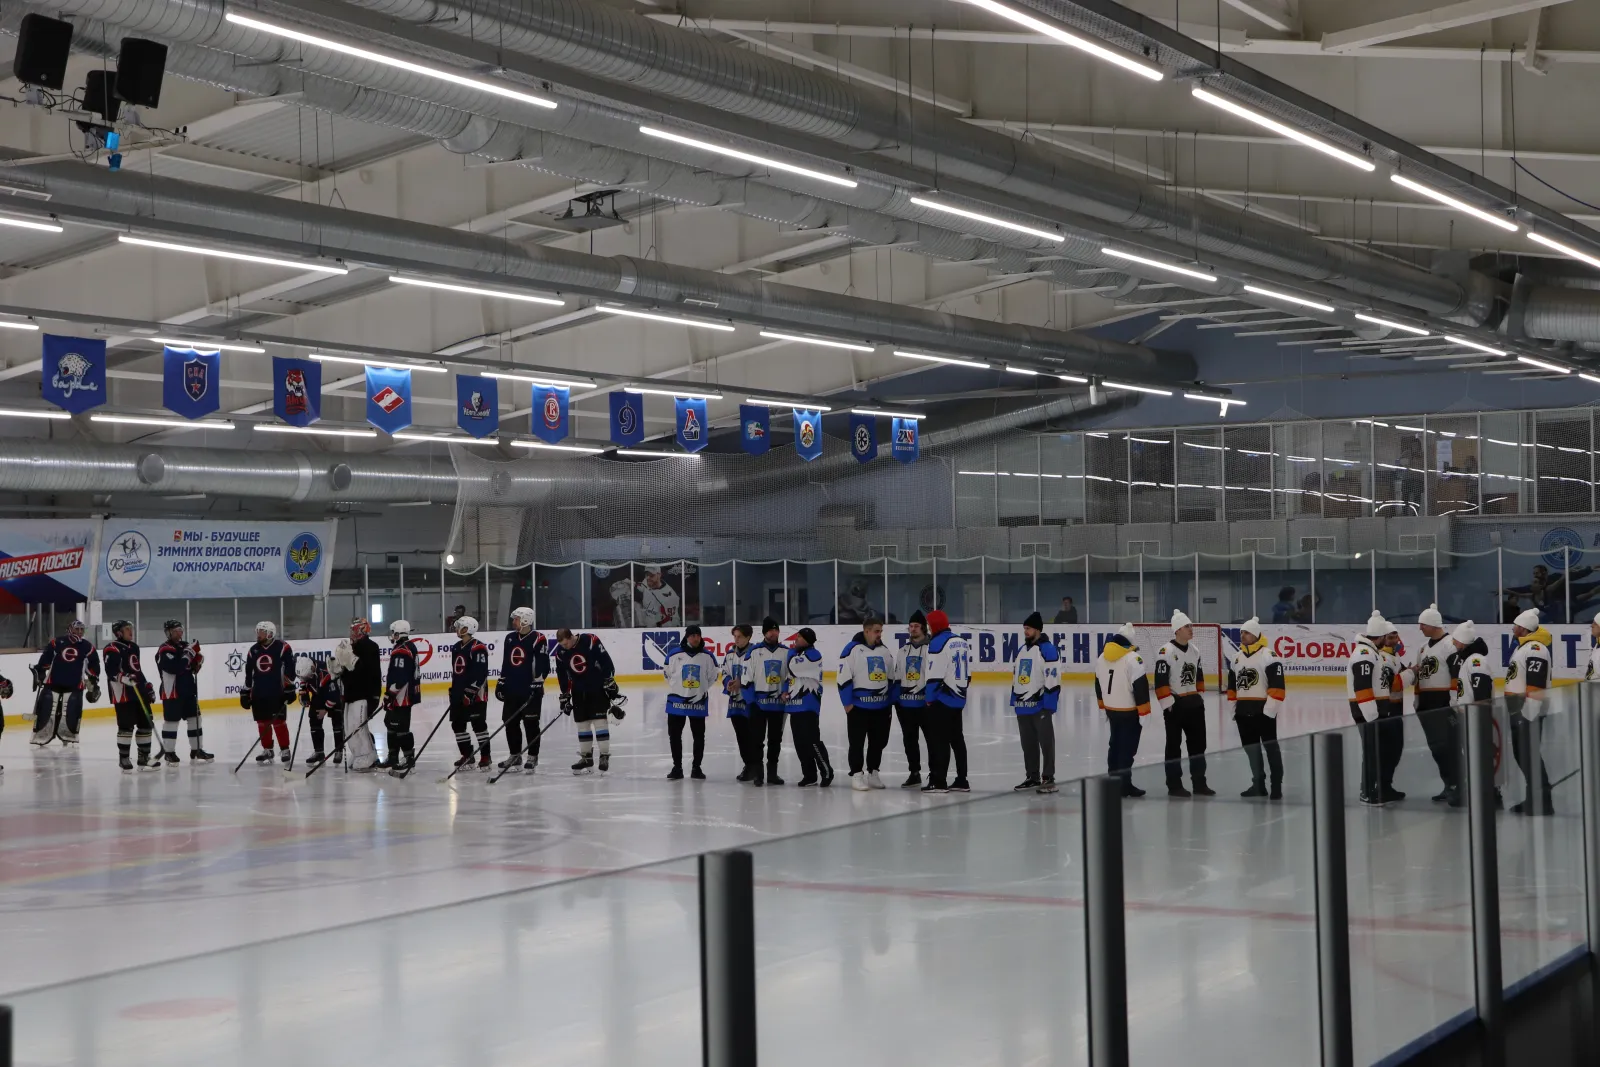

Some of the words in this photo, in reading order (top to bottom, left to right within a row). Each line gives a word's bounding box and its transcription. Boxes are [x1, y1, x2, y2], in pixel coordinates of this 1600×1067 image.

[183, 532, 204, 541] МЫ
[211, 532, 260, 542] БУДУЩЕЕ
[157, 546, 204, 556] ЗИМНИХ
[206, 546, 242, 556] ВИДОВ
[244, 546, 281, 557] СПОРТА
[0, 557, 39, 578] RUSSIA
[40, 550, 82, 572] HOCKEY
[173, 561, 265, 572] ЮЖНОУРАЛЬСКА!
[1360, 663, 1371, 676] 19
[1527, 660, 1542, 673] 23
